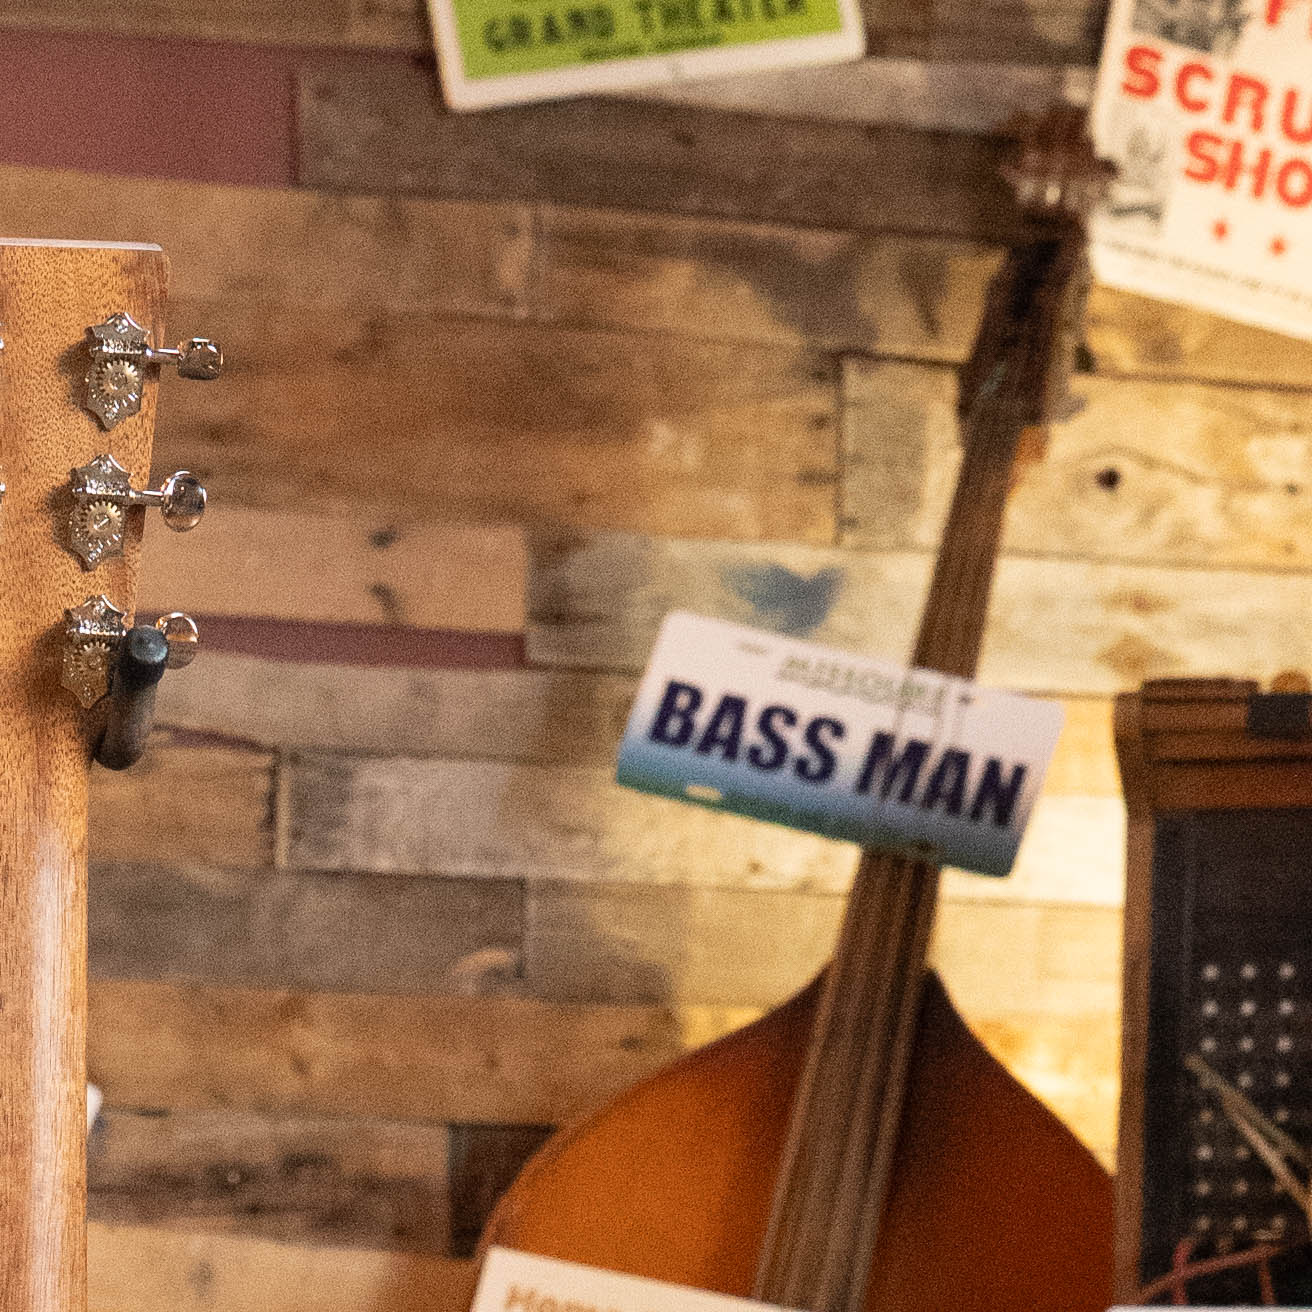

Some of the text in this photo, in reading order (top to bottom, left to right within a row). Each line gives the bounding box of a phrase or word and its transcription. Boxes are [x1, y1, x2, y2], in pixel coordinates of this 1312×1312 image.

[1122, 45, 1312, 143] SCRU
[1184, 129, 1312, 208] SHO
[649, 678, 1026, 826] BASS MAN
